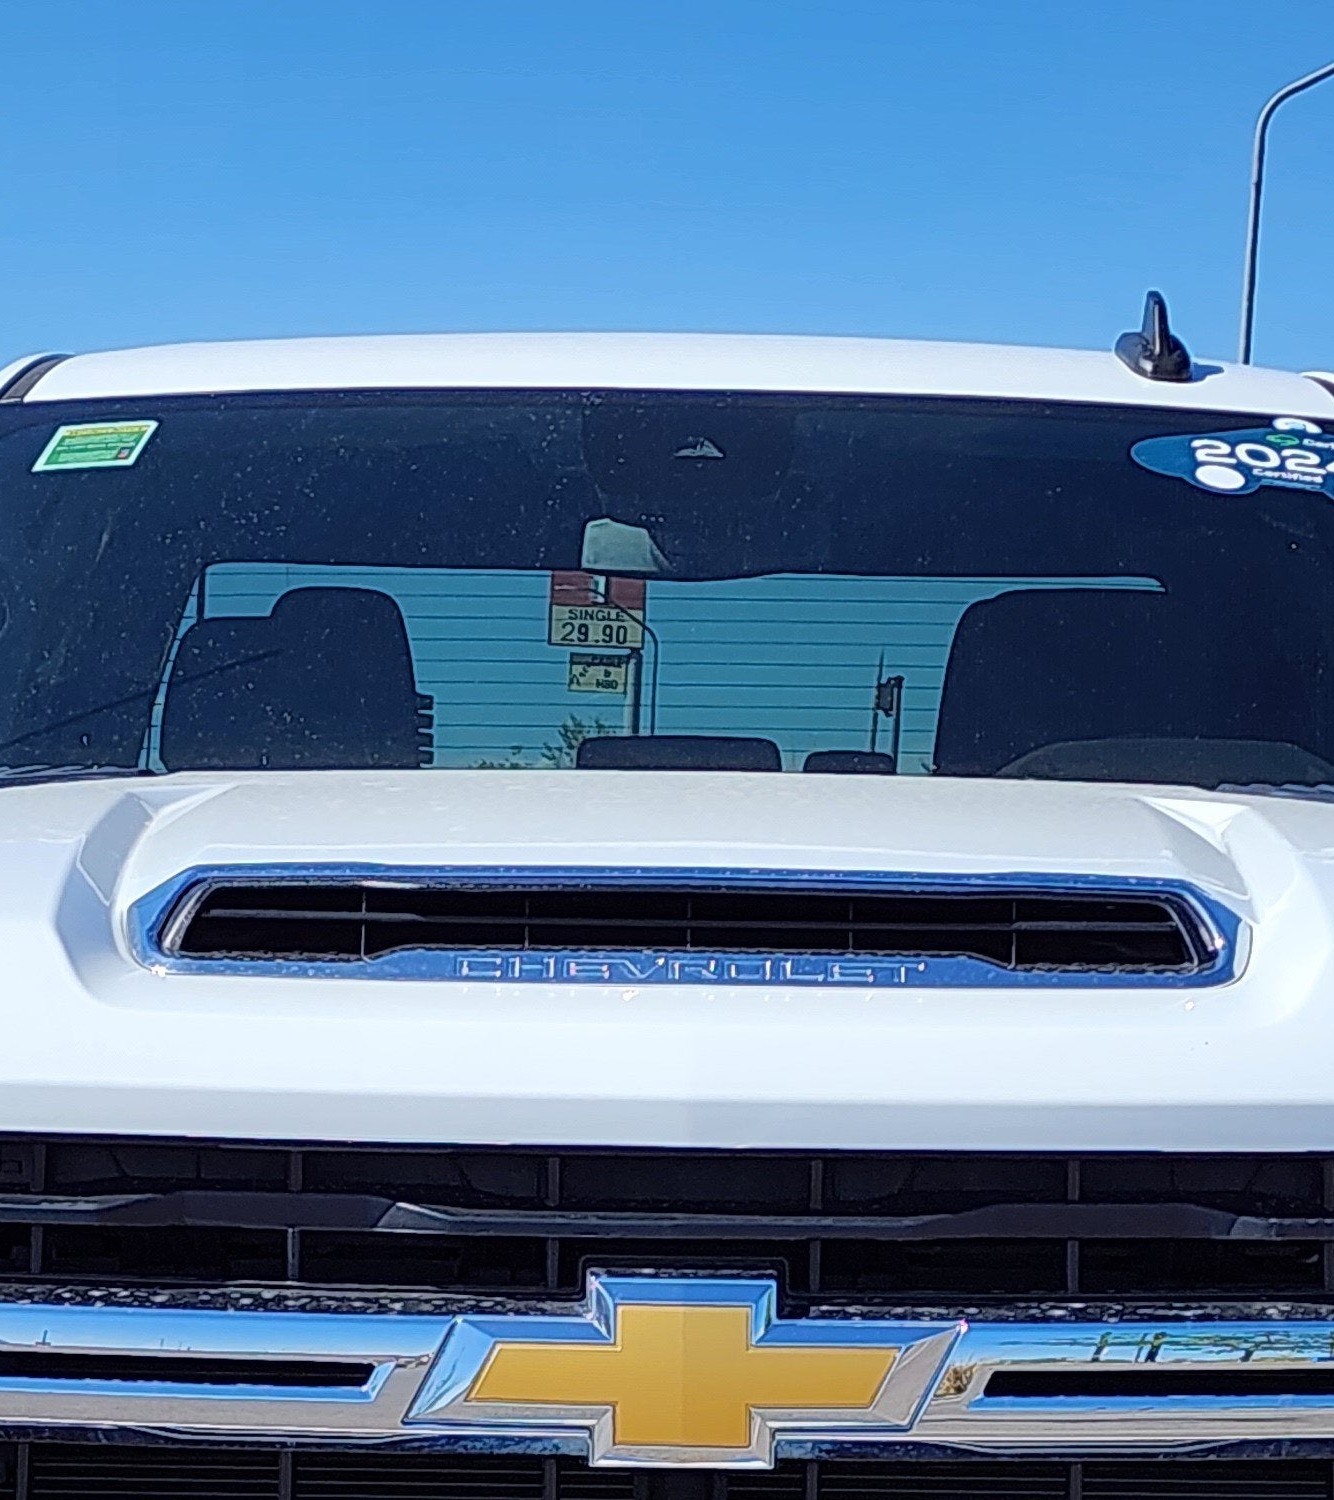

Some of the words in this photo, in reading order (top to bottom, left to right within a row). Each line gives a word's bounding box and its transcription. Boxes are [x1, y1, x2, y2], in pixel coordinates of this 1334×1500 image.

[567, 608, 626, 622] SINGLE
[559, 622, 628, 645] 29.90
[456, 955, 926, 984] CHEVROLET
